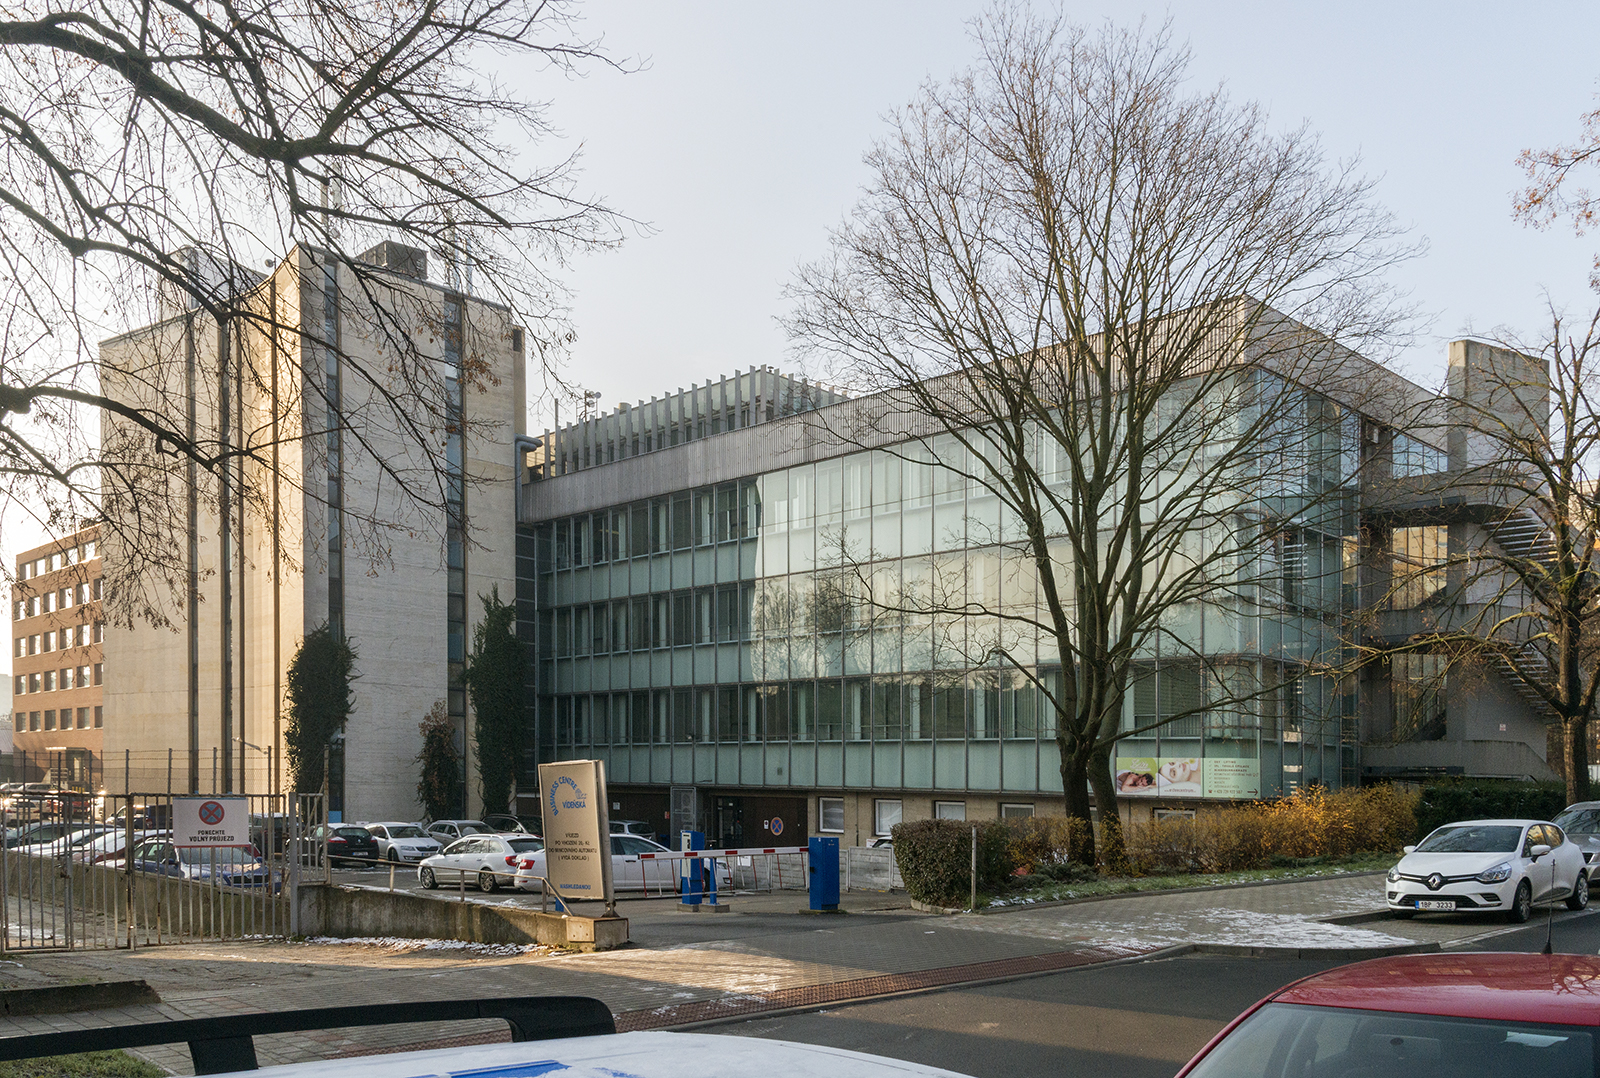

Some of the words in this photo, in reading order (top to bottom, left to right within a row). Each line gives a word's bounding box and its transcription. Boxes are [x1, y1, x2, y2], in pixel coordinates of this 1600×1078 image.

[550, 780, 559, 816] BUSINESS
[558, 776, 577, 790] CENTRE
[562, 800, 586, 808] VÍDEŇSKÁ
